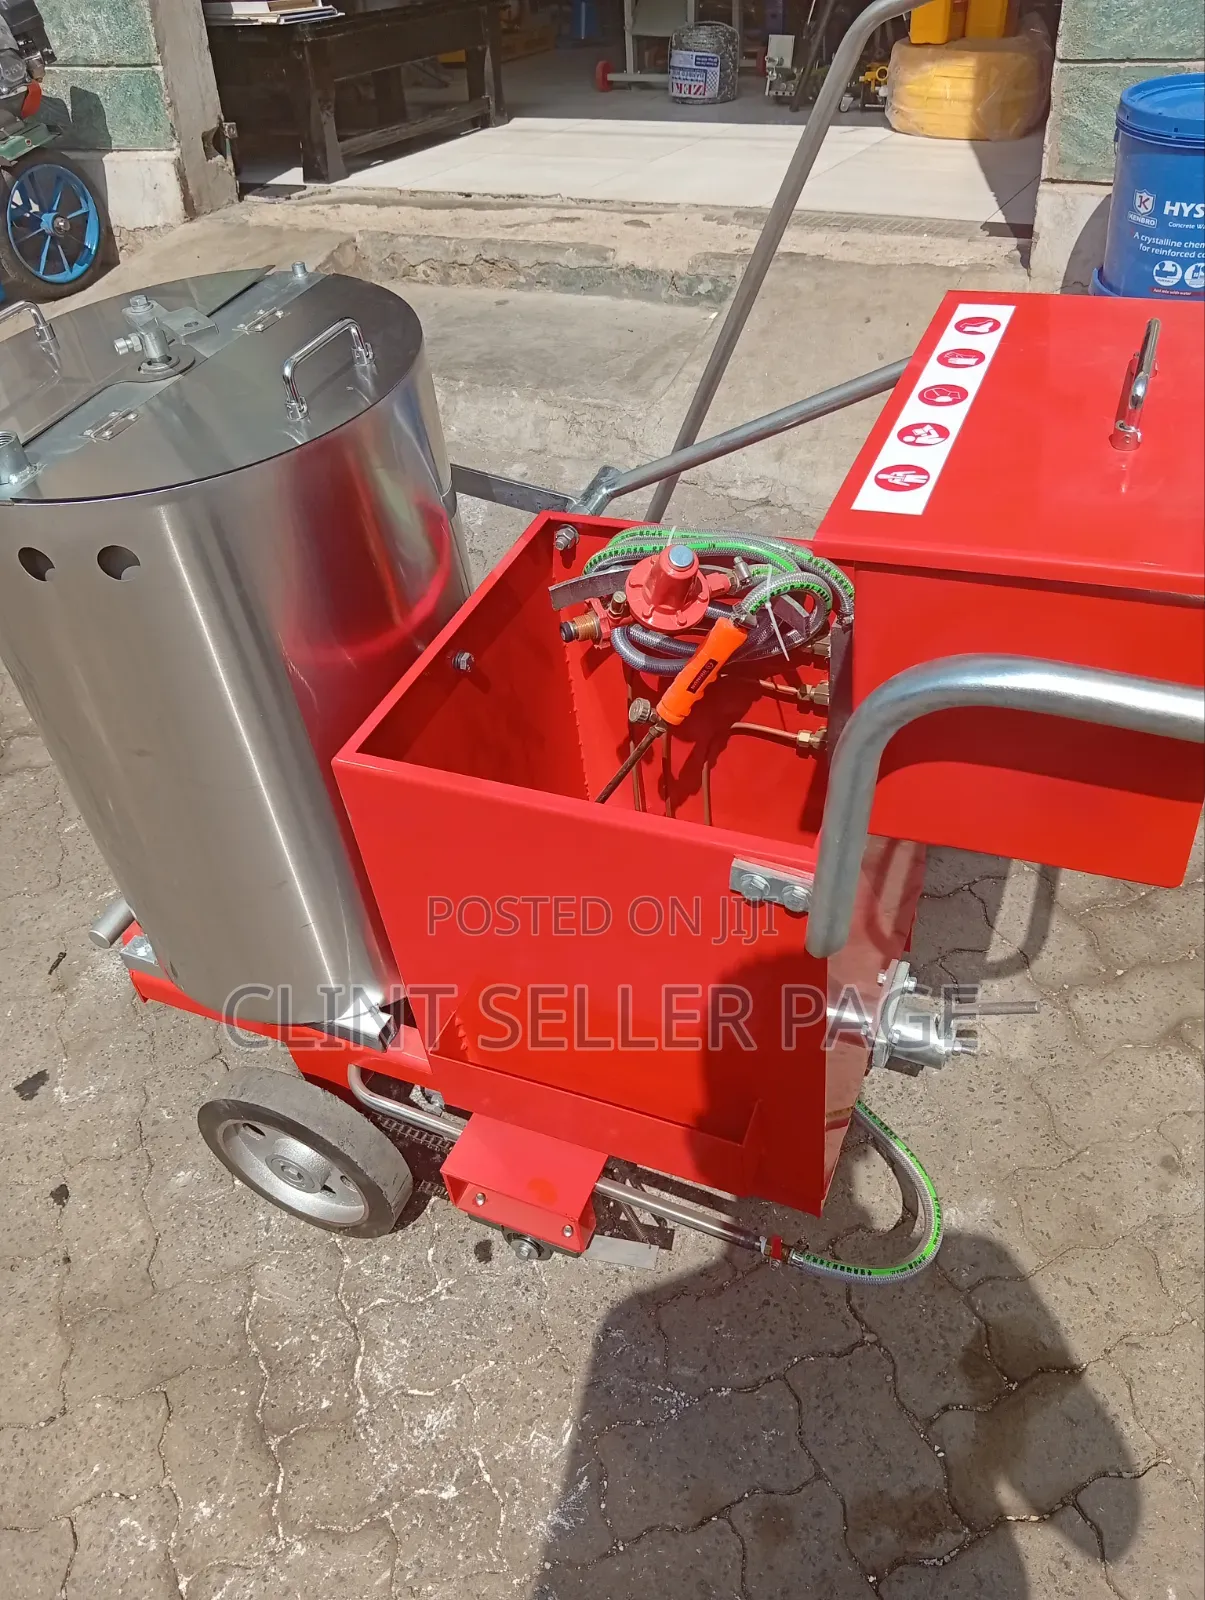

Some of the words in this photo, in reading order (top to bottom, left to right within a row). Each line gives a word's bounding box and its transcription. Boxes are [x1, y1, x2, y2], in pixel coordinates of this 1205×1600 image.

[1128, 213, 1156, 226] KENBRO
[1168, 221, 1196, 230] Concrete
[1133, 231, 1140, 239] A
[1140, 233, 1183, 248] crystalline
[1139, 243, 1150, 252] for
[1151, 247, 1196, 259] reinforced
